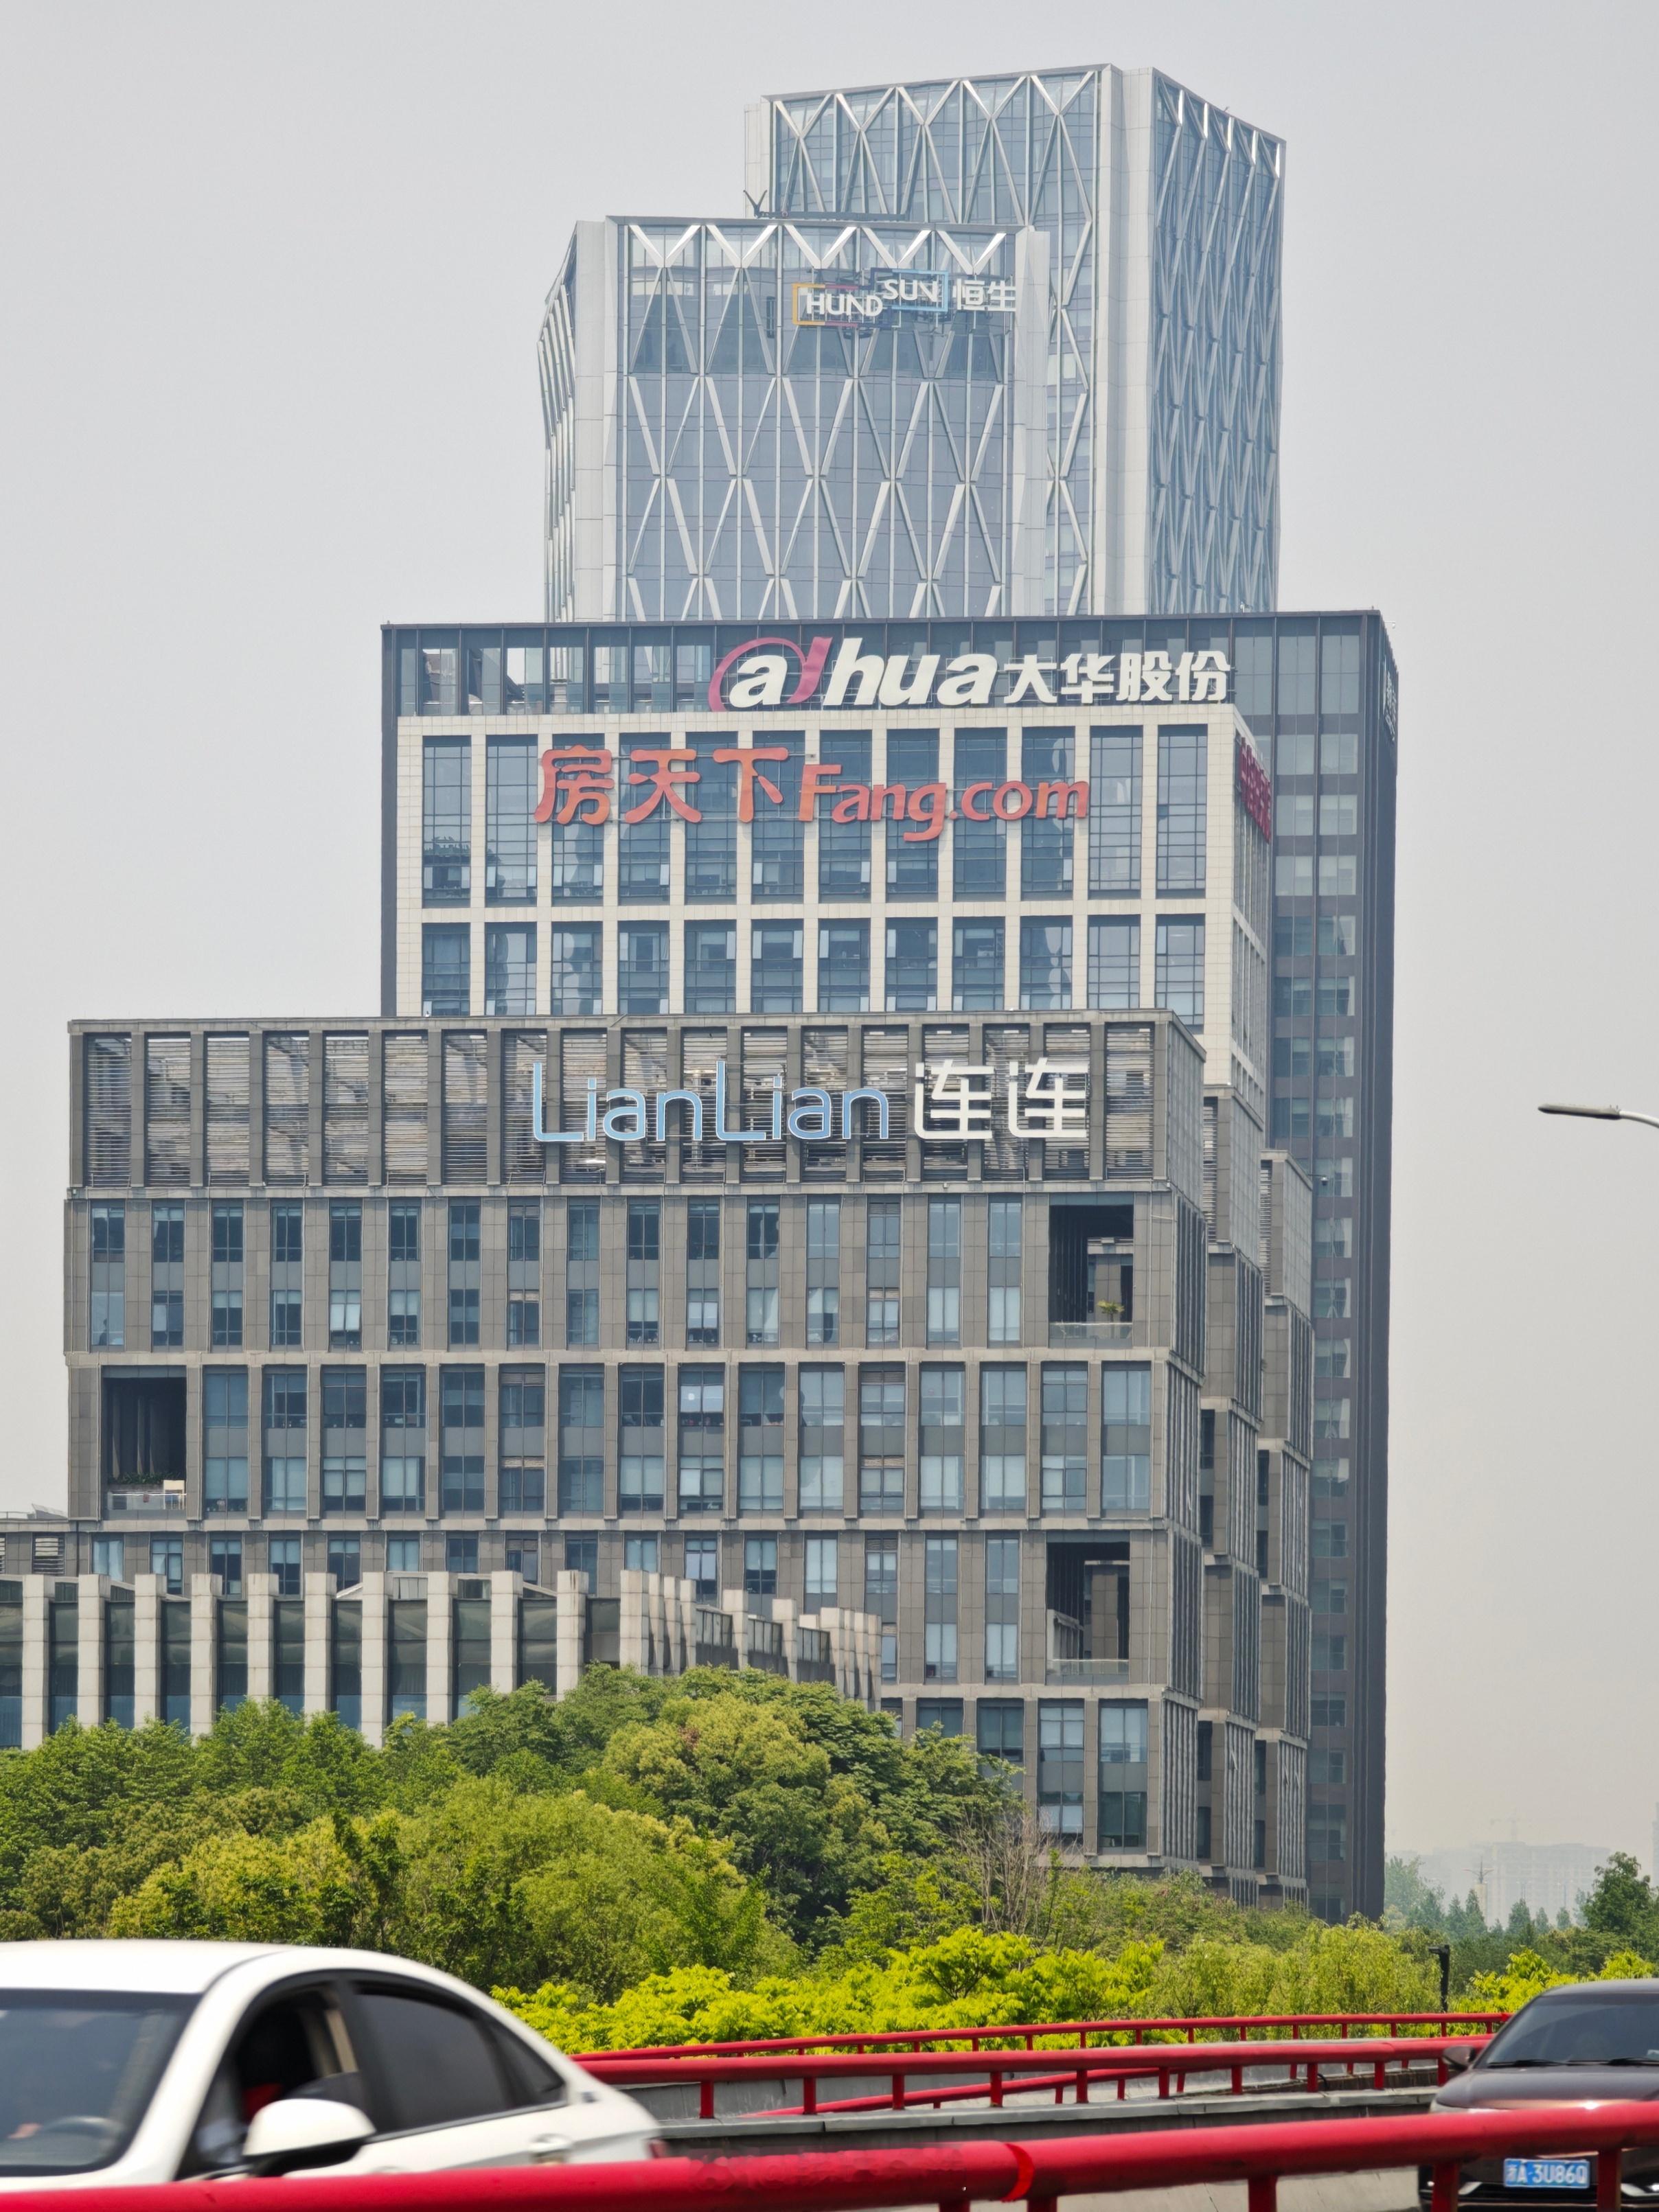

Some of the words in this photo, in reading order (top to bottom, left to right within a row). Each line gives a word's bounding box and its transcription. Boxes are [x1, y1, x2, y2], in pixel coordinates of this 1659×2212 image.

[806, 292, 883, 316] HUND
[883, 279, 939, 302] SUN
[953, 279, 1016, 311] 恒生
[1004, 651, 1231, 704] 大华股份
[534, 745, 788, 825] 房天下
[799, 764, 1090, 842] Fang.com
[533, 1061, 889, 1142] LianLian
[914, 1058, 1088, 1139] 连连
